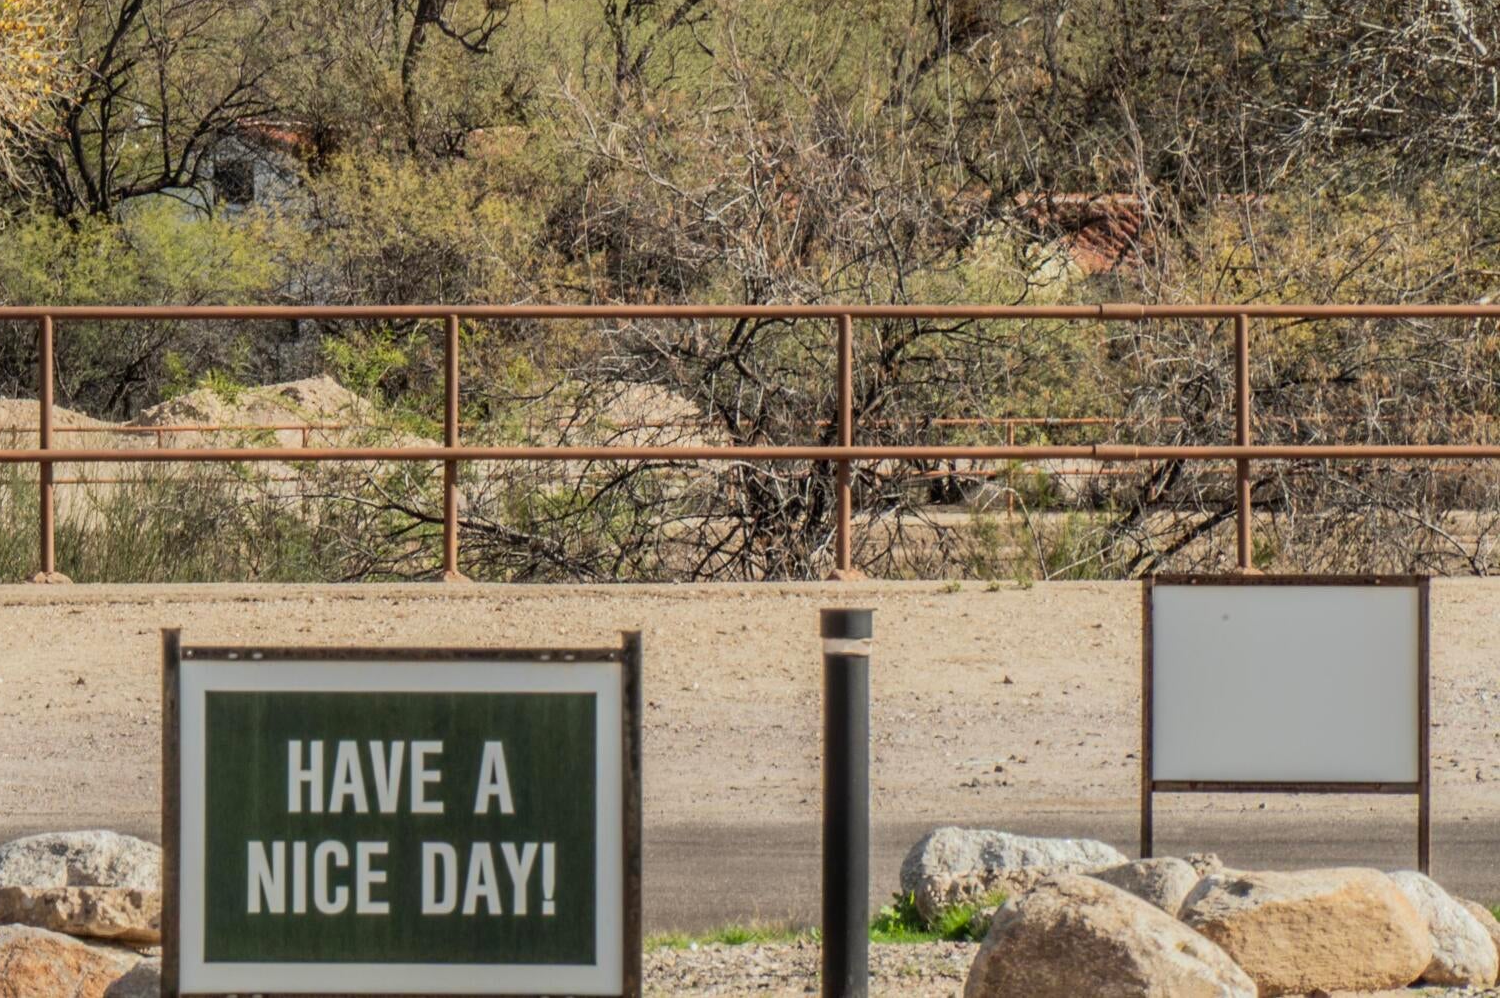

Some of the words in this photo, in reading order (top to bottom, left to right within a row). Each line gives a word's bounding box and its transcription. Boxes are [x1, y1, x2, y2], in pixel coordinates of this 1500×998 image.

[288, 740, 444, 814] HAVE
[474, 740, 514, 815] A
[247, 841, 390, 915] NICE
[422, 842, 556, 916] DAY!
